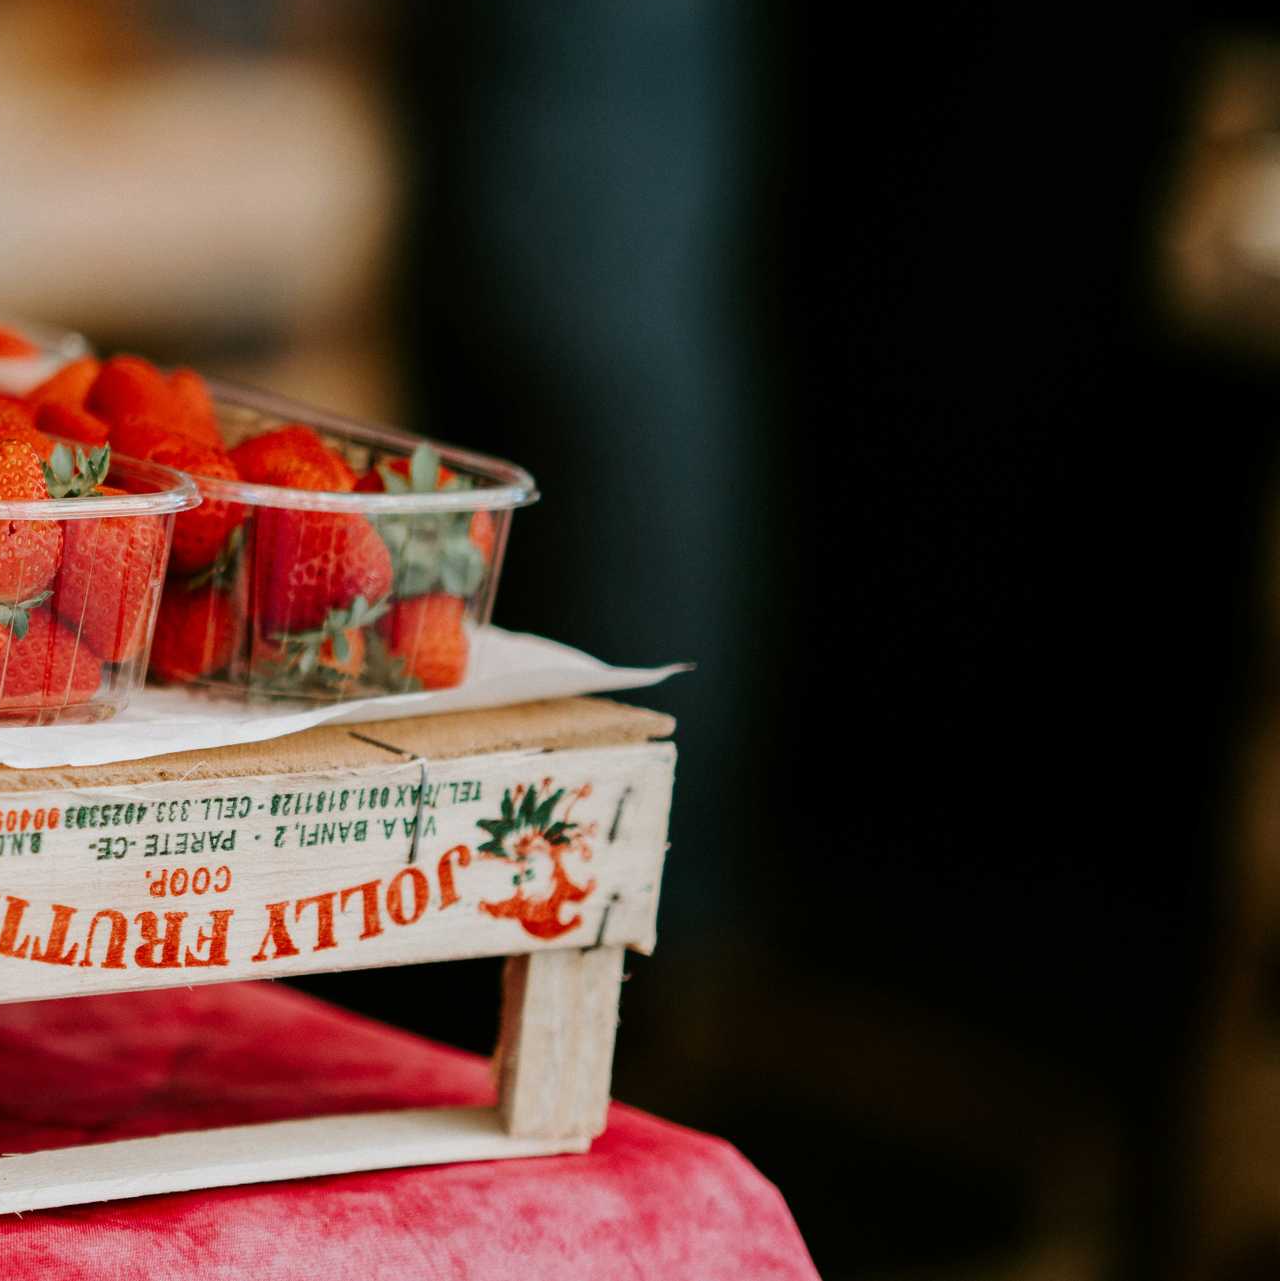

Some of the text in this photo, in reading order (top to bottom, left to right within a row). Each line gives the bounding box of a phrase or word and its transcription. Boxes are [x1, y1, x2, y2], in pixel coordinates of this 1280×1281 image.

[273, 825, 285, 848] 2
[294, 819, 368, 848] BANFI,
[405, 817, 438, 840] VA
[144, 830, 237, 857] PARETE
[144, 865, 232, 898] COOP.
[251, 844, 472, 963] JOLLY
